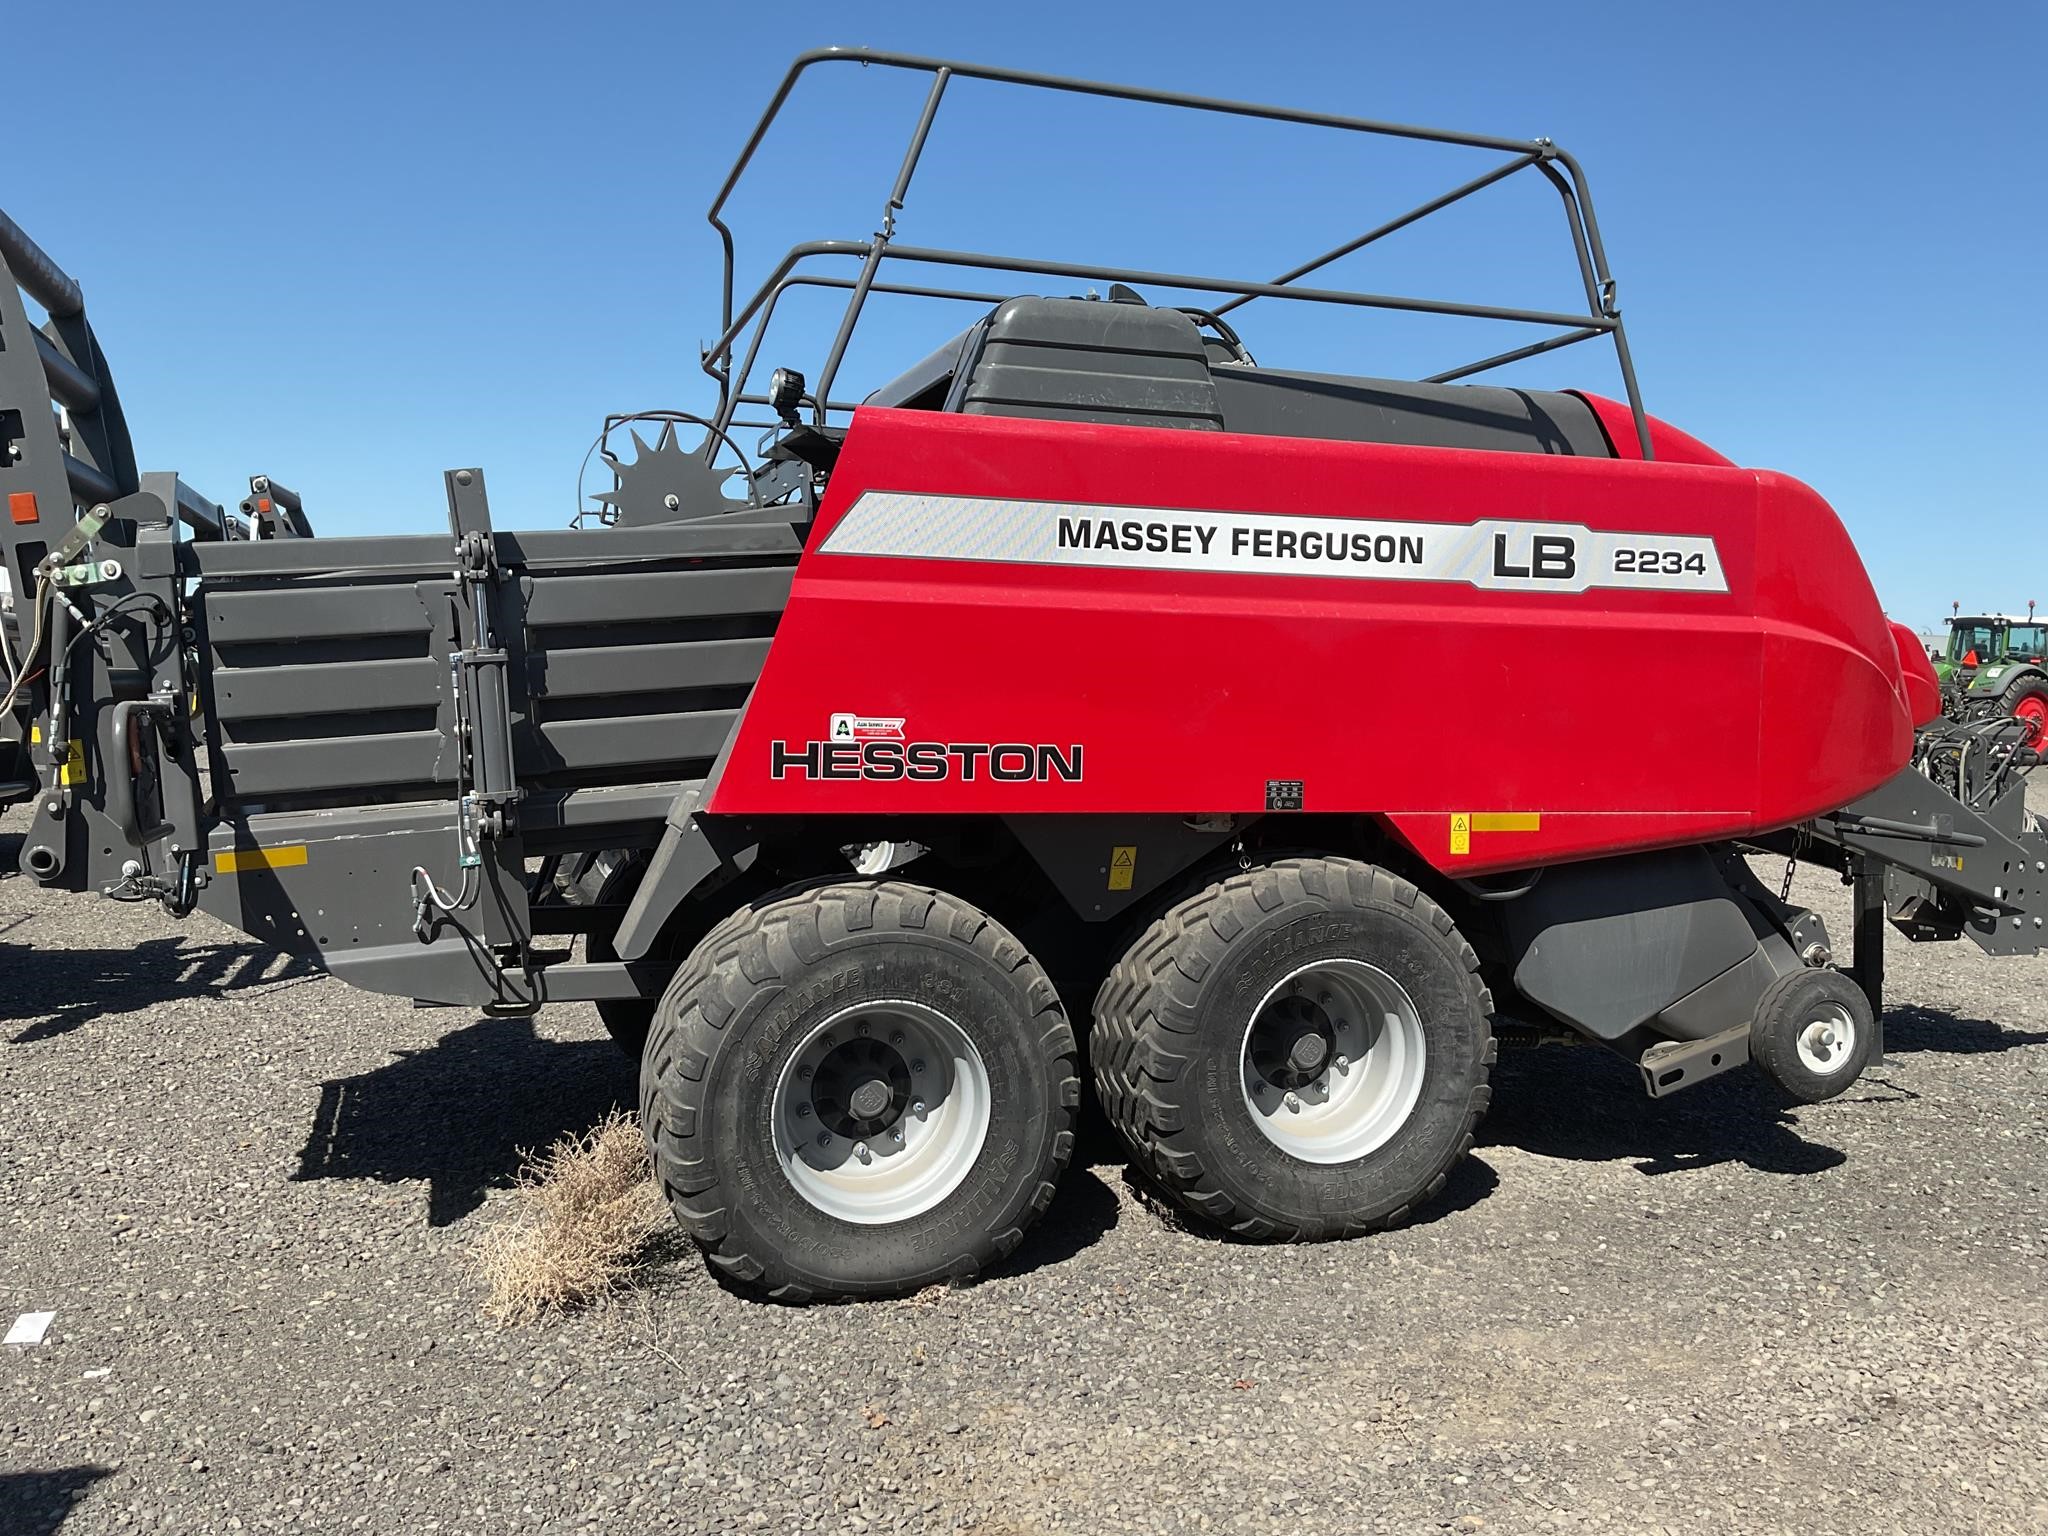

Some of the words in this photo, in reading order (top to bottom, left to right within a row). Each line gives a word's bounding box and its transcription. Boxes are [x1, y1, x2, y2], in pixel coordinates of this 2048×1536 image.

[1058, 518, 1218, 555] MASSEY
[1231, 528, 1424, 564] FERGUSON
[1491, 534, 1578, 579] LB
[1613, 550, 1707, 577] 2234
[771, 741, 1083, 782] HESSTON
